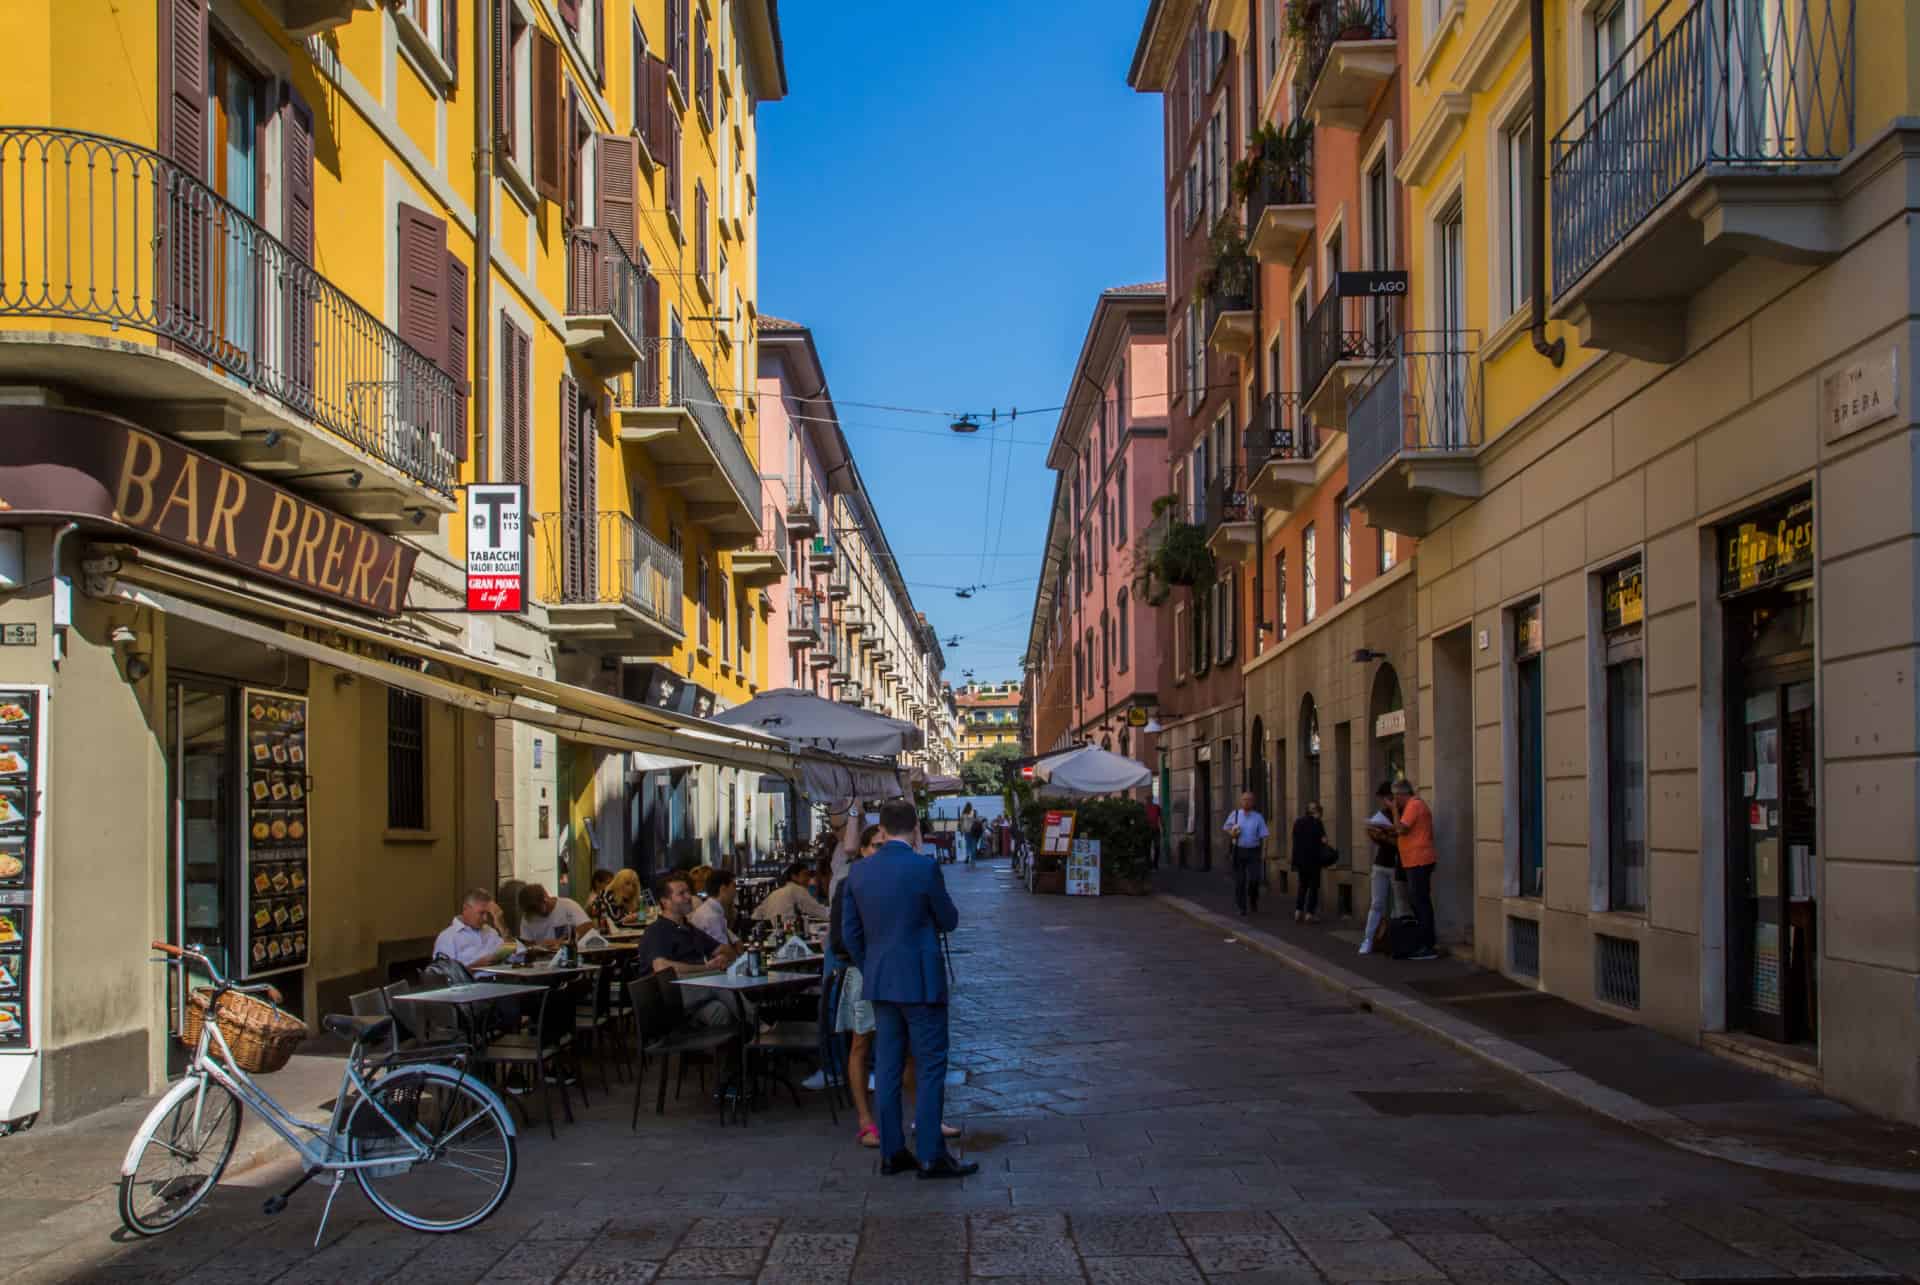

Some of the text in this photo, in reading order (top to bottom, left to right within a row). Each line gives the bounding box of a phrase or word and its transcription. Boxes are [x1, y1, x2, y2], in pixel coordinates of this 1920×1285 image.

[1369, 280, 1406, 293] LAGO
[1831, 390, 1881, 425] BRERA
[112, 429, 403, 615] BAR BRERA
[474, 492, 516, 548] T
[469, 551, 520, 561] TABACCHI
[470, 562, 520, 572] VALORI BOLLATI
[468, 578, 494, 590] GRAN
